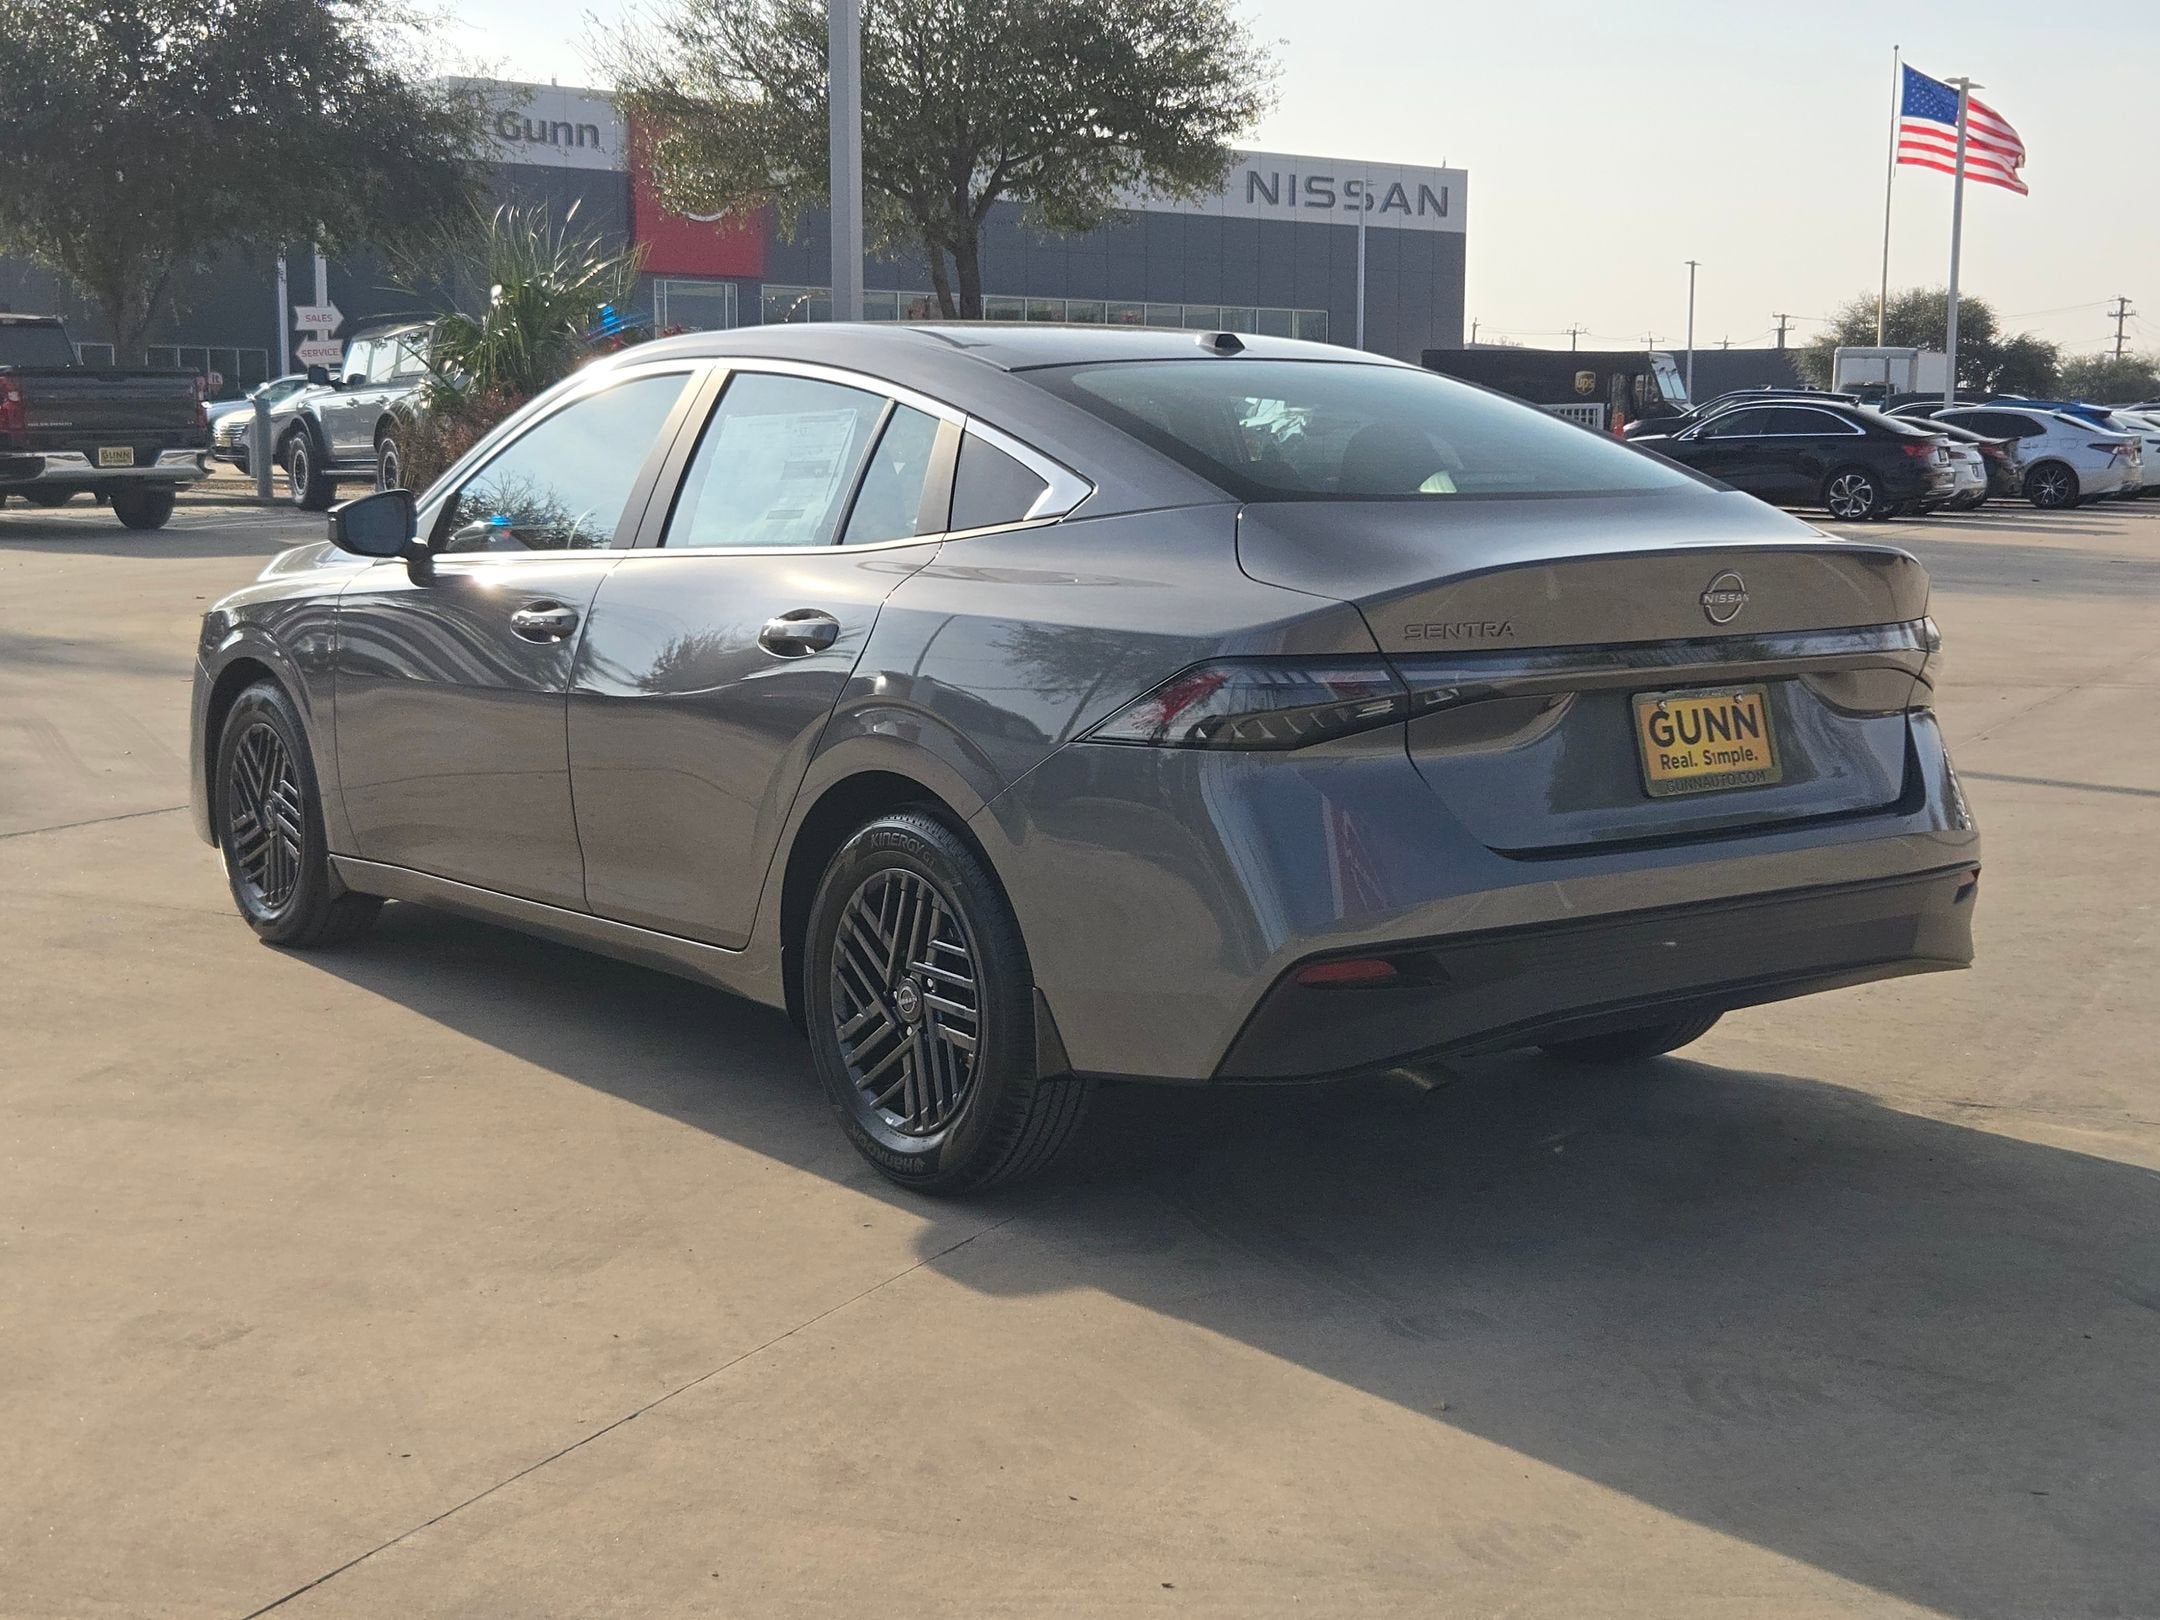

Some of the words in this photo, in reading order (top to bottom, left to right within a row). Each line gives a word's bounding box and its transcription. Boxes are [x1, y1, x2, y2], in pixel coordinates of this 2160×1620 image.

[497, 110, 600, 149] Gunn
[1246, 170, 1449, 218] NISSAN
[305, 313, 333, 323] SALES
[301, 347, 340, 358] SERVICE
[102, 450, 131, 459] GUNN
[1703, 592, 1750, 604] NISSAN
[1404, 620, 1514, 640] SENTRA
[1649, 703, 1760, 748] GUNN
[1660, 751, 1698, 770] Real.
[1704, 746, 1758, 766] Simple.
[1666, 770, 1766, 793] GUNNAUTO.COM
